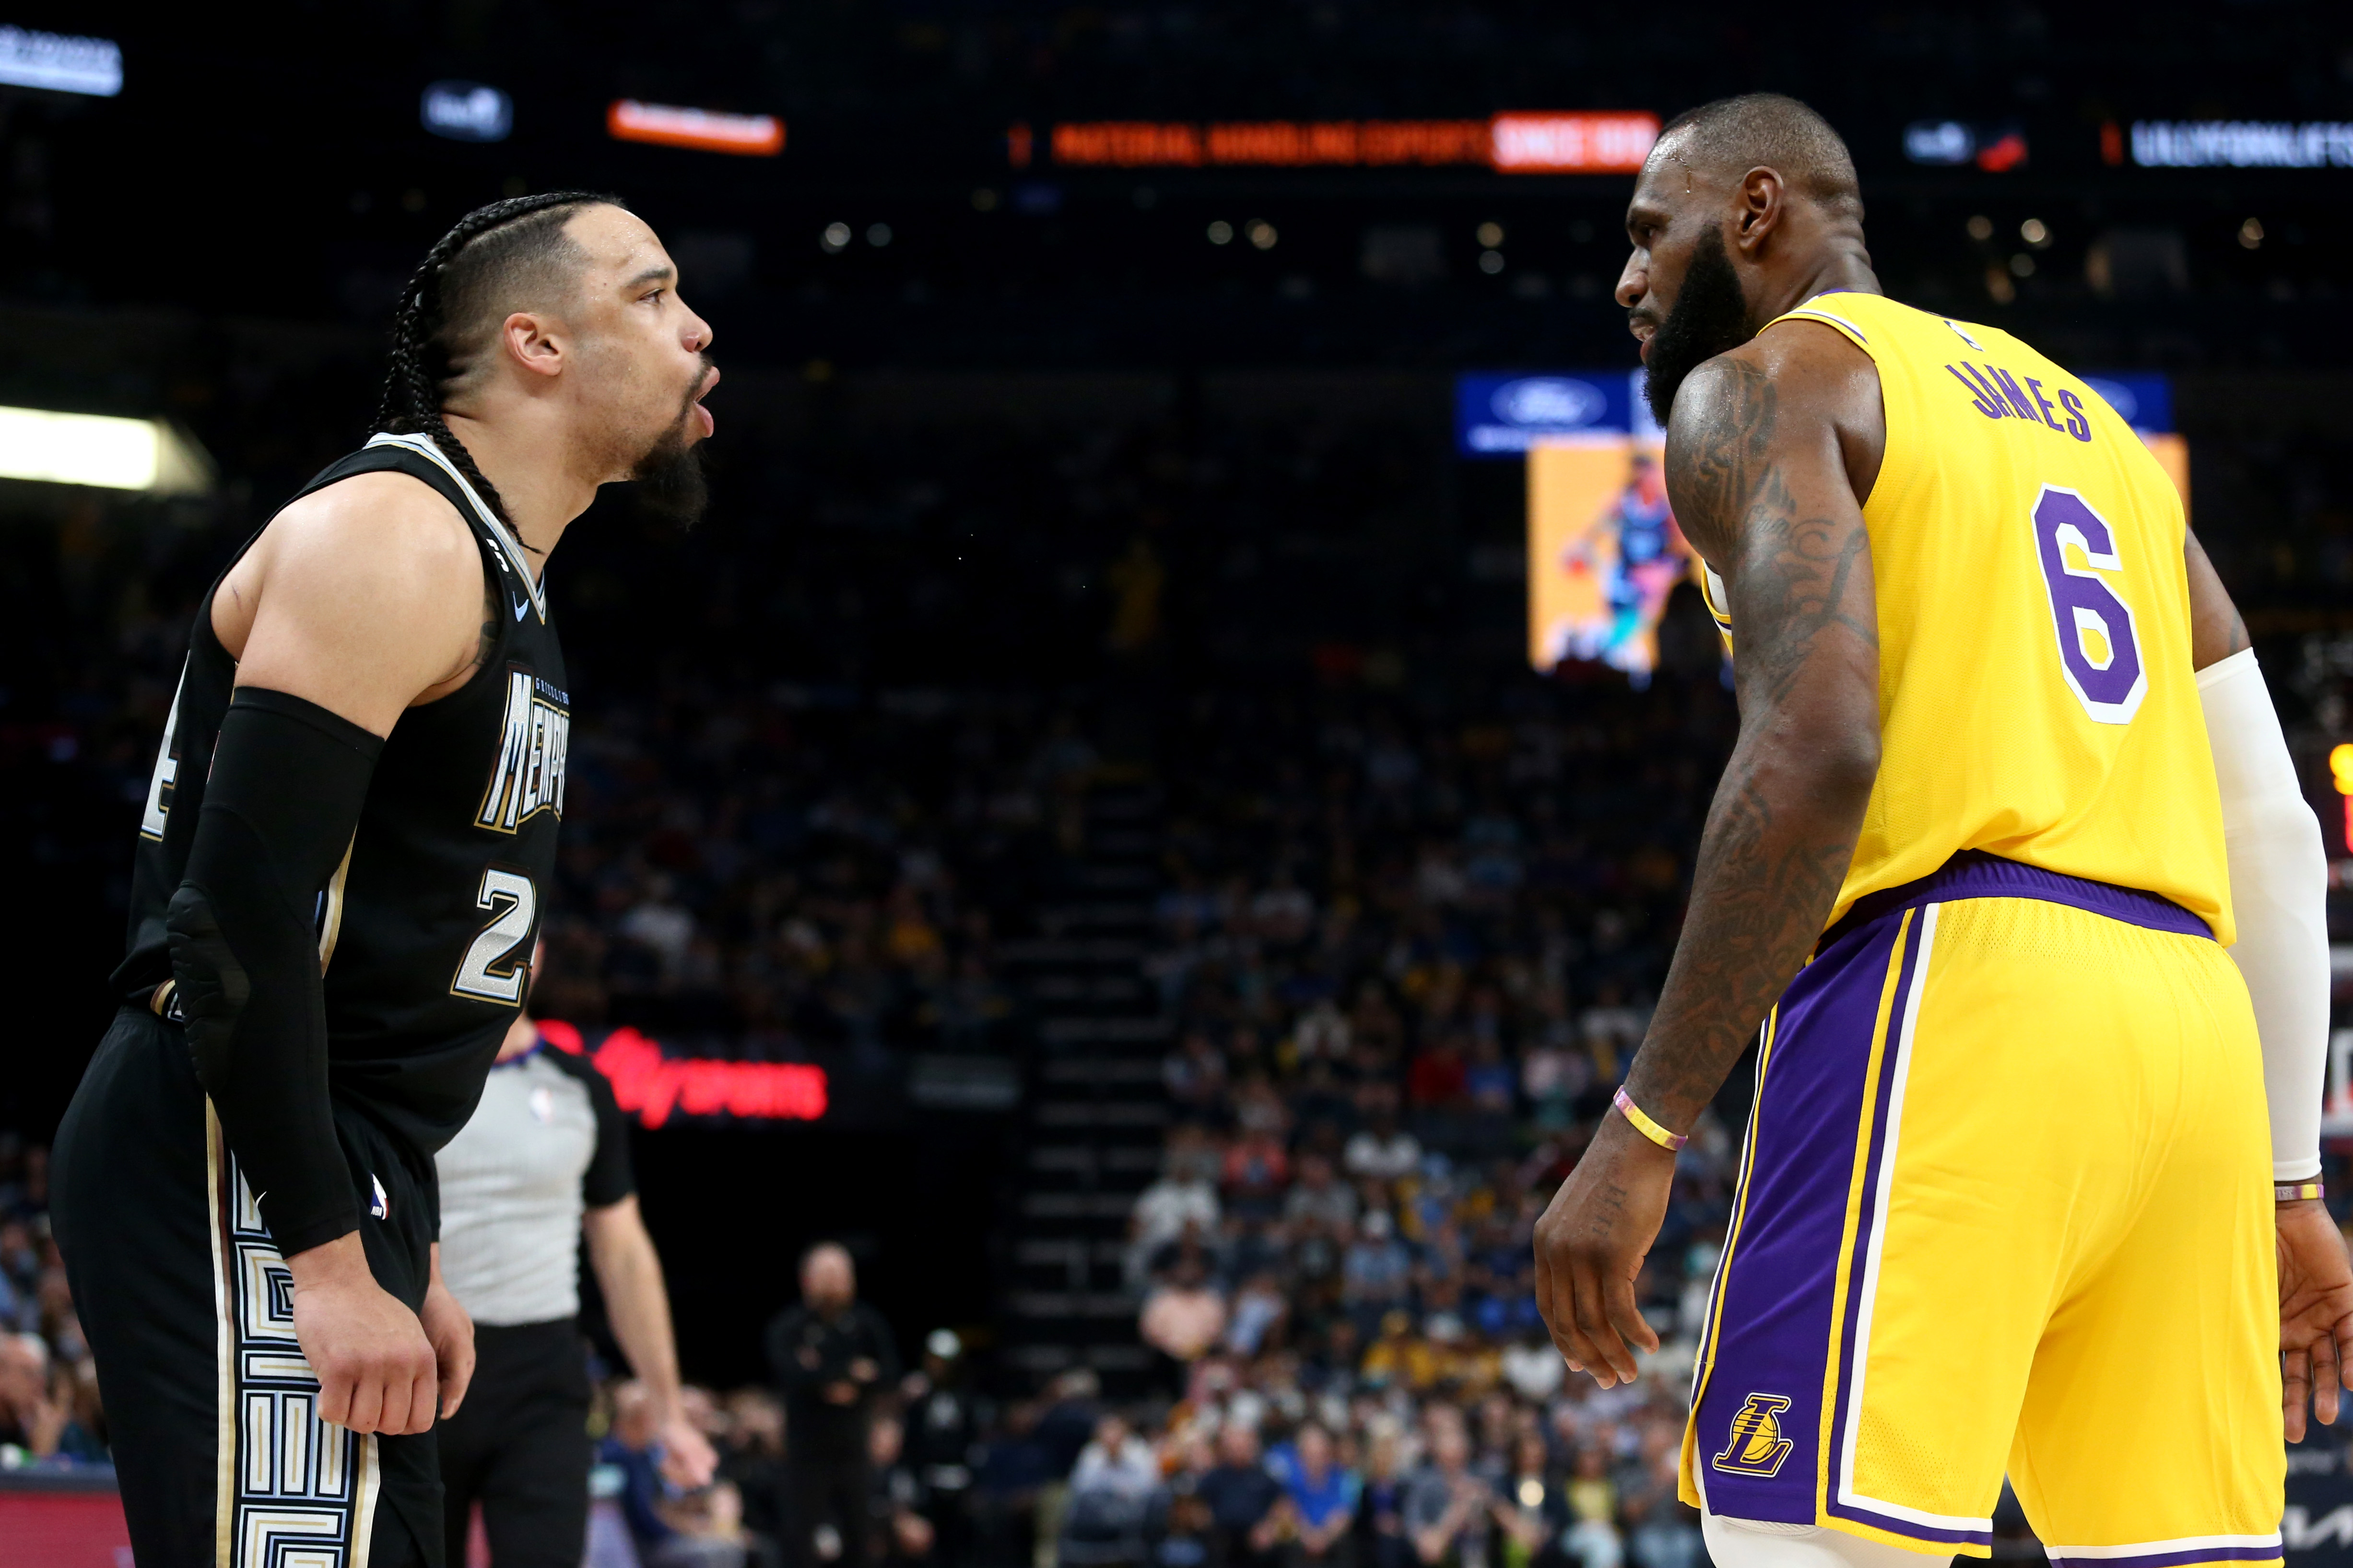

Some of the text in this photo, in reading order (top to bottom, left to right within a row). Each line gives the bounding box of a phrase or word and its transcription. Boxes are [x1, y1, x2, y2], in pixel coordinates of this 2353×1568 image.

[1944, 361, 2092, 443] JAMES
[2029, 481, 2149, 725] 6
[371, 1205, 382, 1217] NBA
